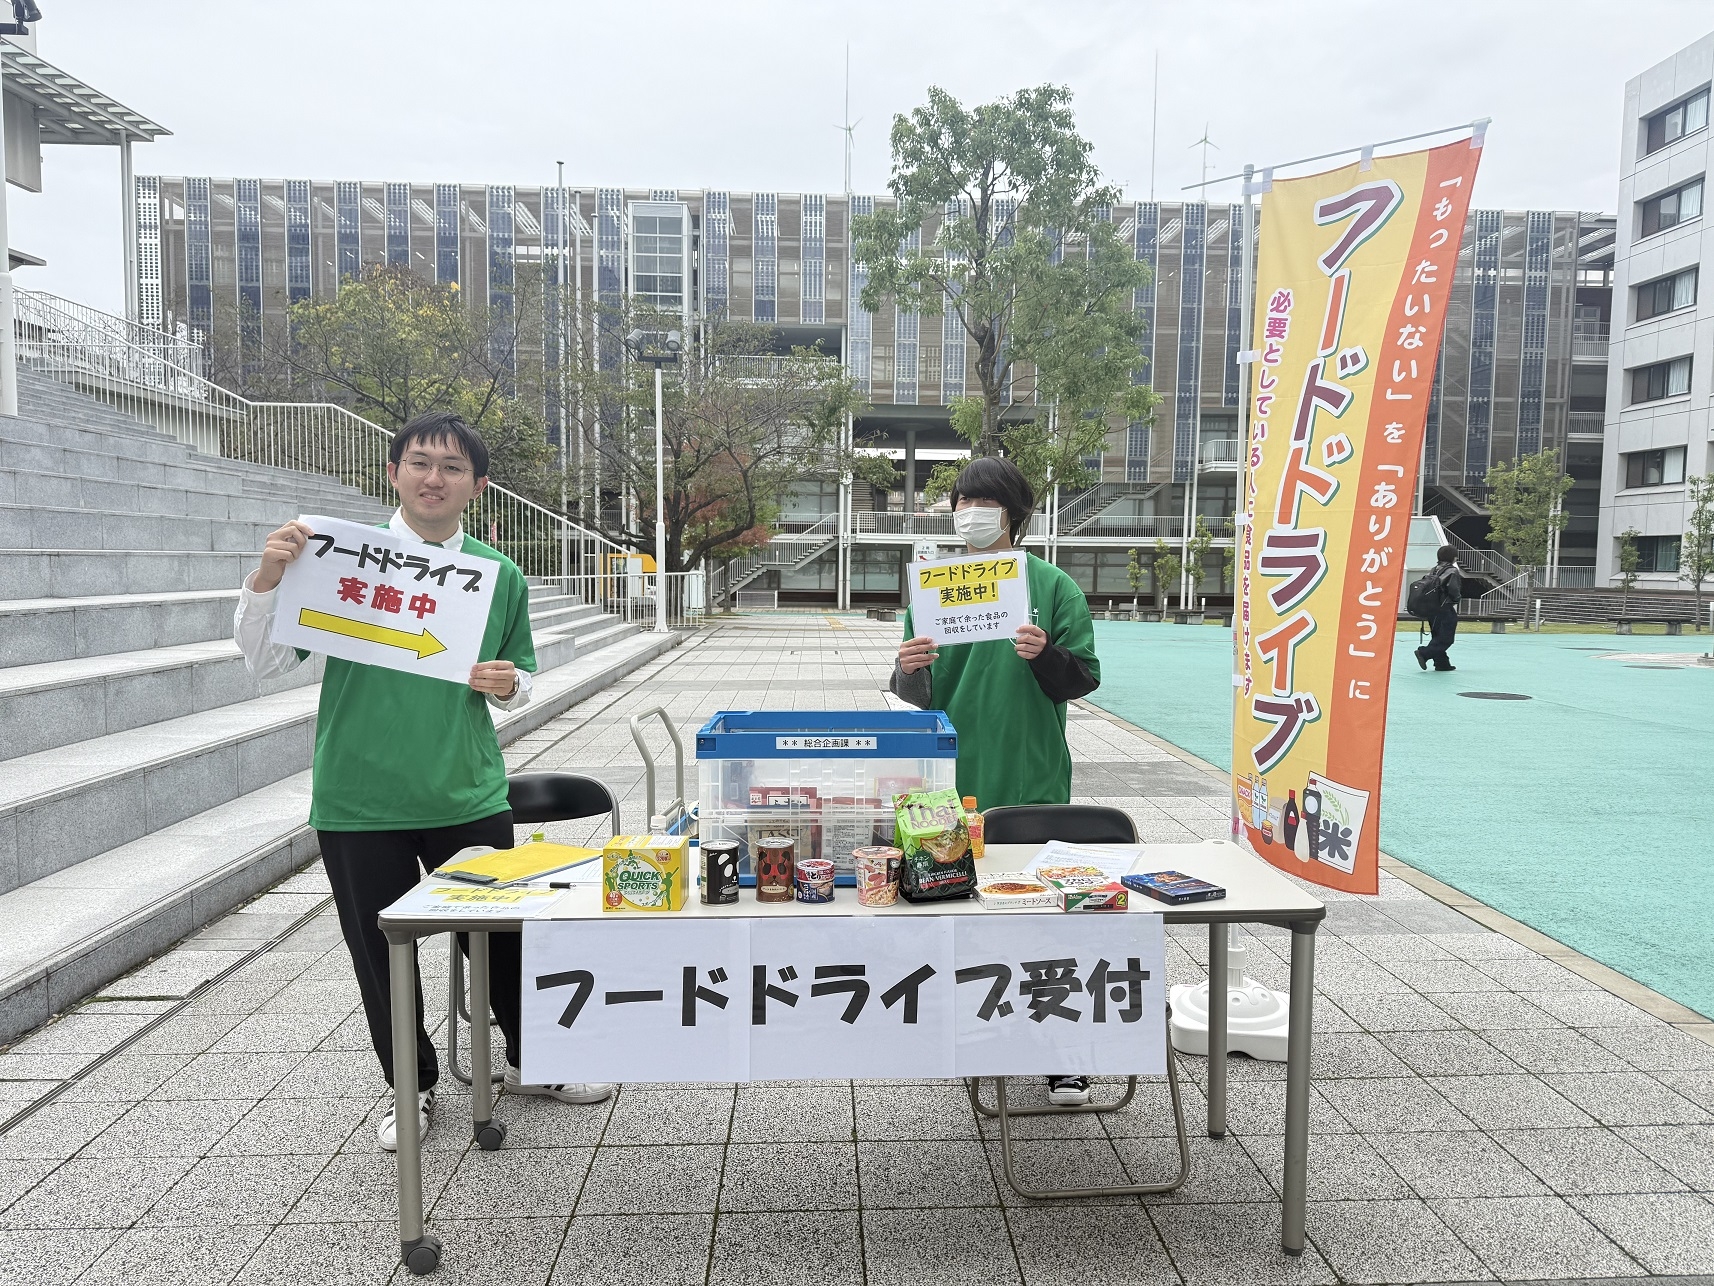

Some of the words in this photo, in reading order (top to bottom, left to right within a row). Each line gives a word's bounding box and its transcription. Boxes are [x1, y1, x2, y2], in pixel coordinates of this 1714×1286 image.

[1252, 181, 1402, 773] フードドライブ
[307, 533, 483, 593] フードドライブ
[919, 557, 1018, 585] フードドライブ
[336, 576, 438, 620] 実施中
[940, 582, 997, 604] 実施中!
[934, 611, 1009, 626] ご家庭で余った食品の
[944, 622, 1000, 635] 回収をしています
[803, 738, 850, 749] 総合企画課
[1318, 818, 1353, 862] 米
[617, 881, 659, 890] SPORTS
[619, 870, 660, 883] QUICK
[1021, 897, 1052, 906] ミートソース
[1116, 893, 1127, 906] 2
[535, 957, 1151, 1029] フードドライブ受付
